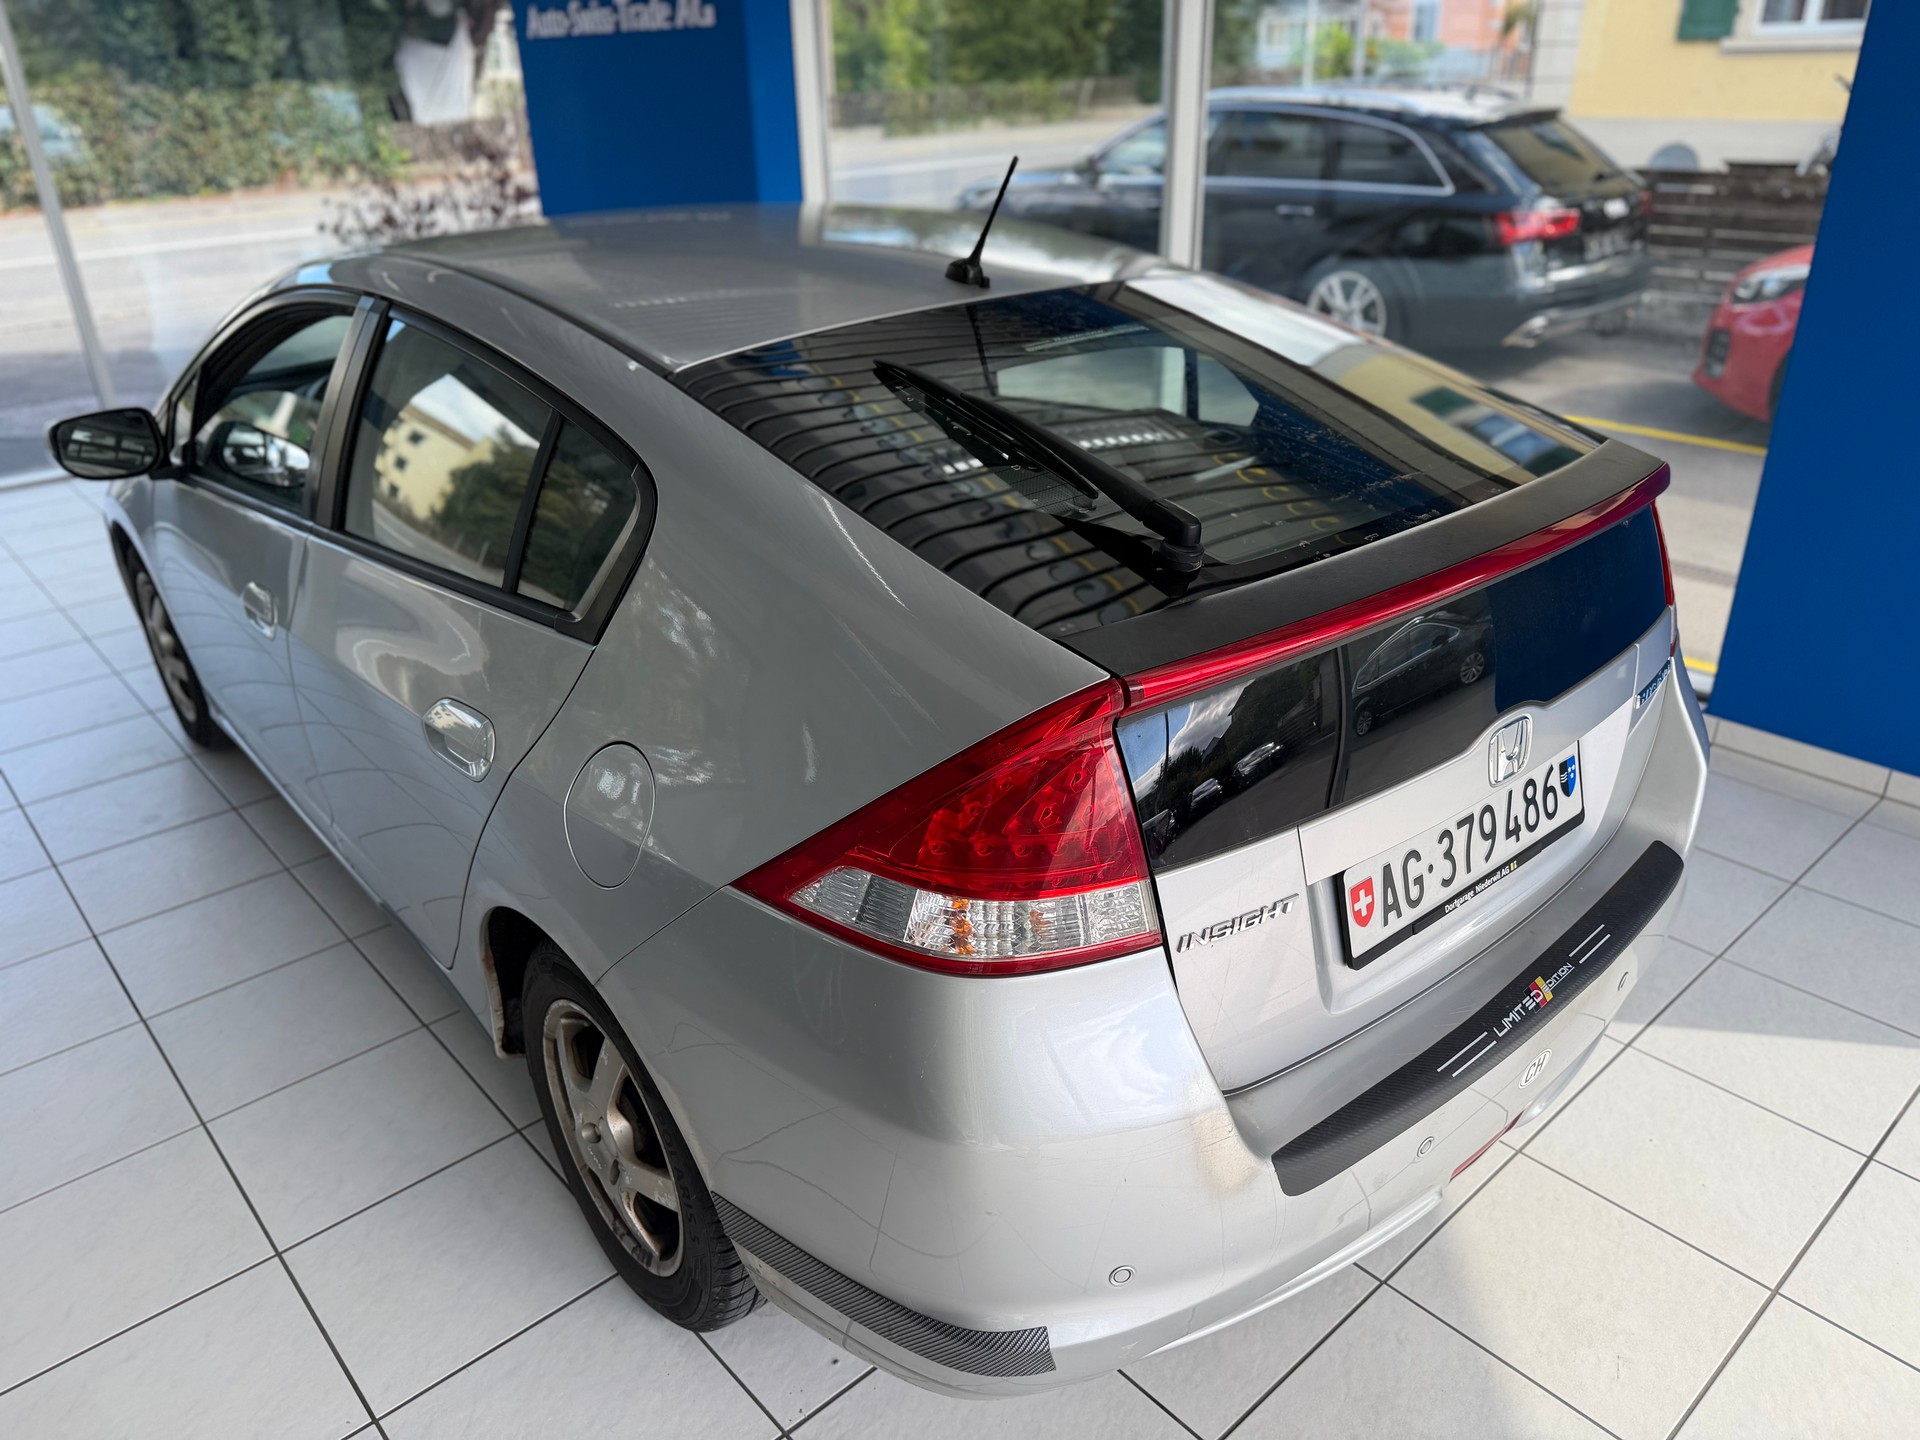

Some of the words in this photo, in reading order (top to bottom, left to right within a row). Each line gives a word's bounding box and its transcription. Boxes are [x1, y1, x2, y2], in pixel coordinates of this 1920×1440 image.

[1176, 892, 1300, 954] INSIGHT
[1493, 988, 1544, 1038] LIMITED
[1541, 962, 1574, 993] EDITION
[1524, 1052, 1547, 1084] CH
